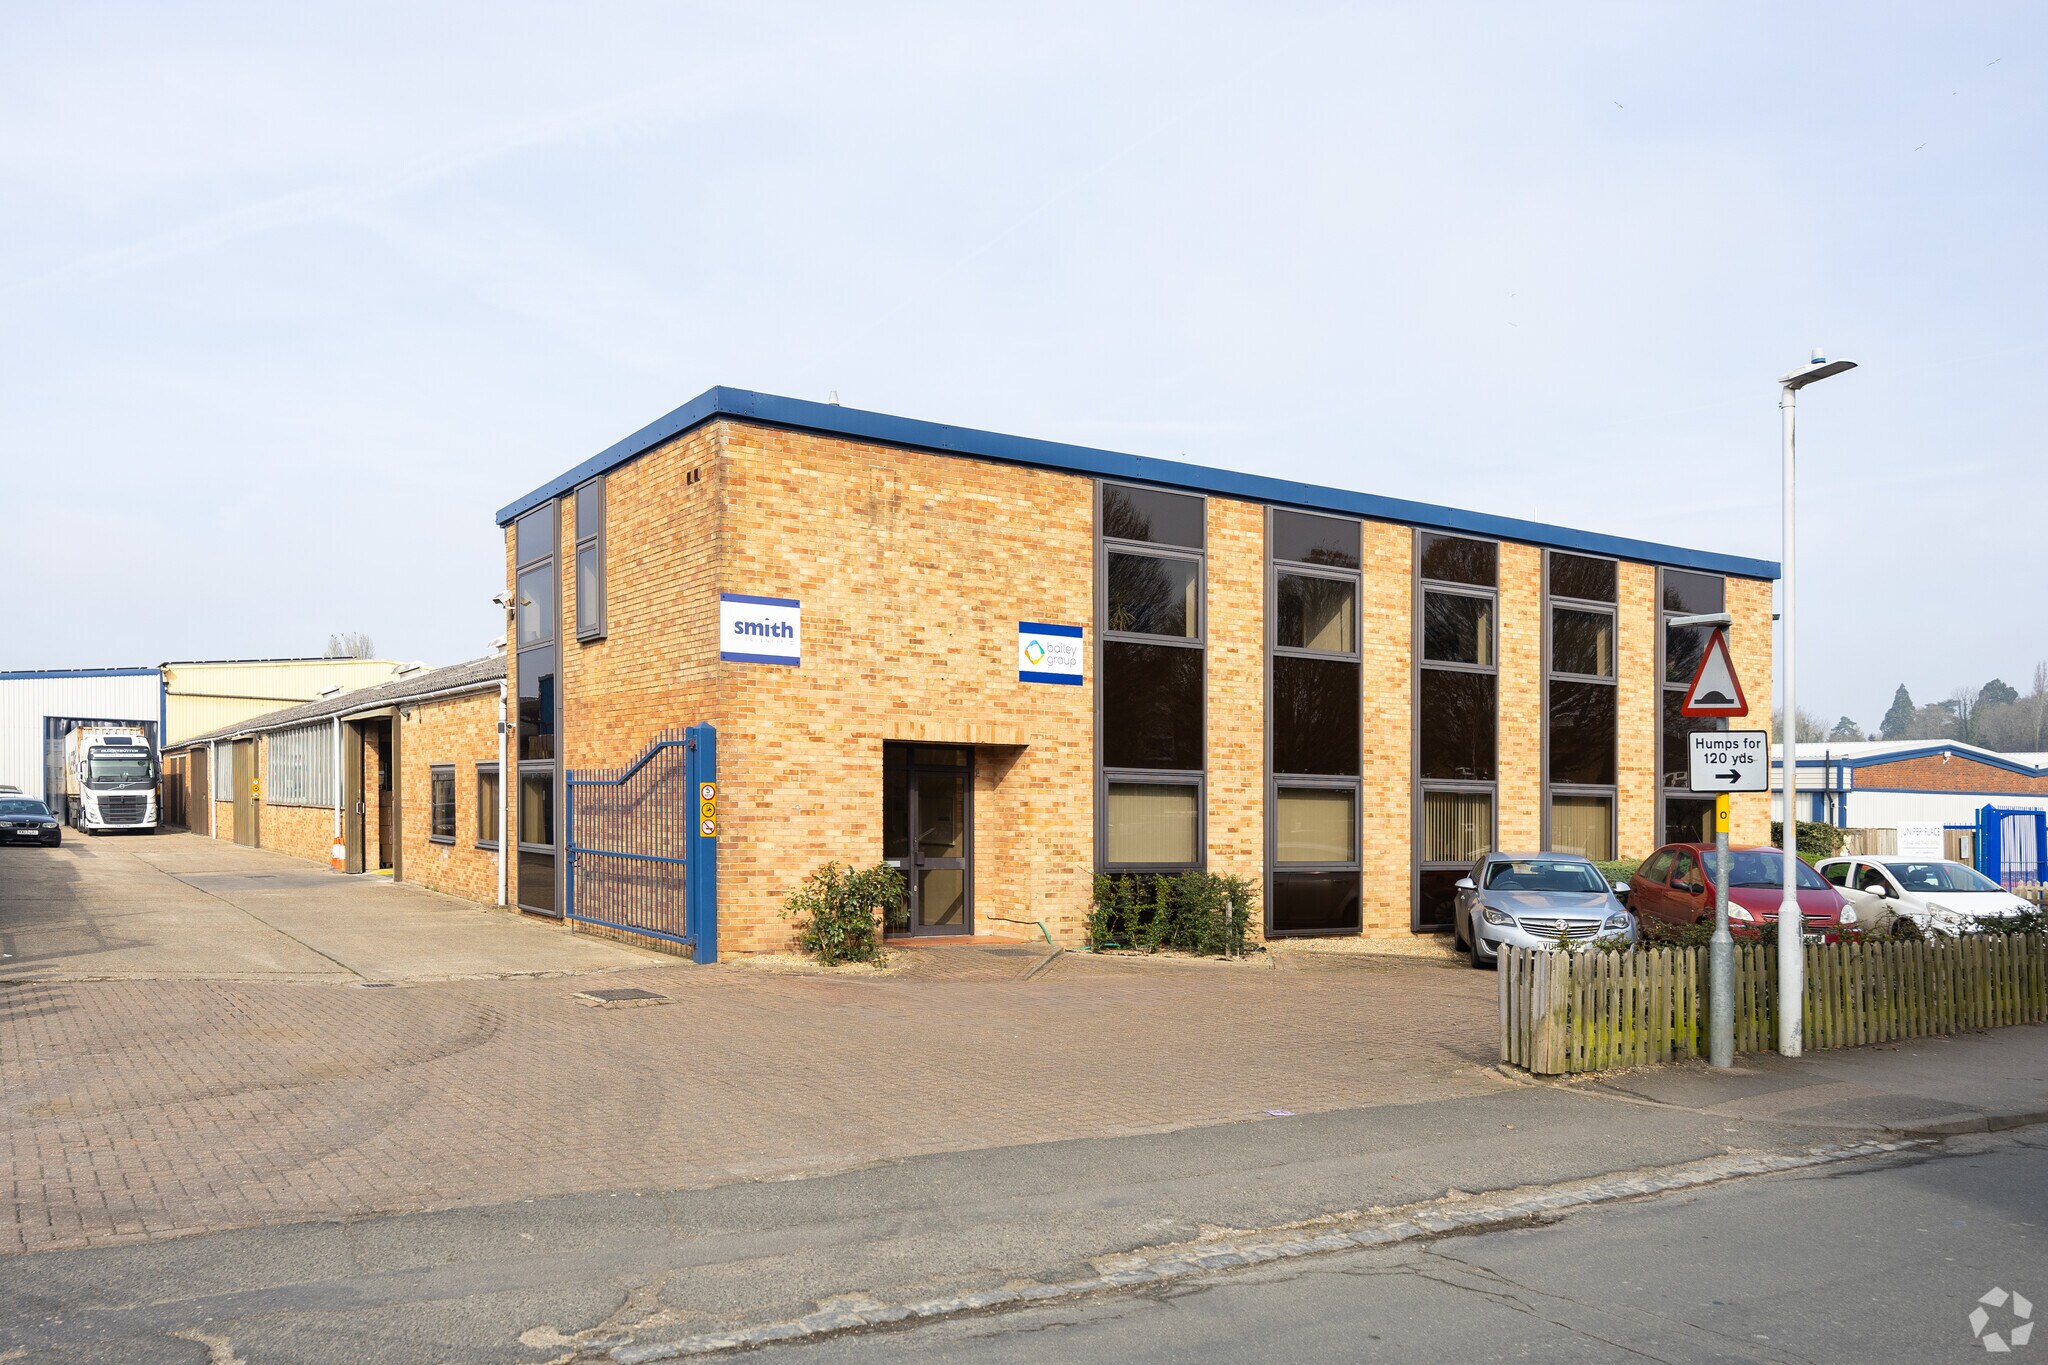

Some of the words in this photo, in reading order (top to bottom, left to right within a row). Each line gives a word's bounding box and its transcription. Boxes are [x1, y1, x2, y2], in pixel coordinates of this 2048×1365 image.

[734, 618, 794, 638] smith
[1046, 641, 1077, 657] bailey
[1046, 656, 1077, 668] group
[1695, 737, 1739, 753] Humps
[1743, 737, 1761, 749] for
[1704, 752, 1727, 764] 120
[1732, 752, 1754, 767] yds
